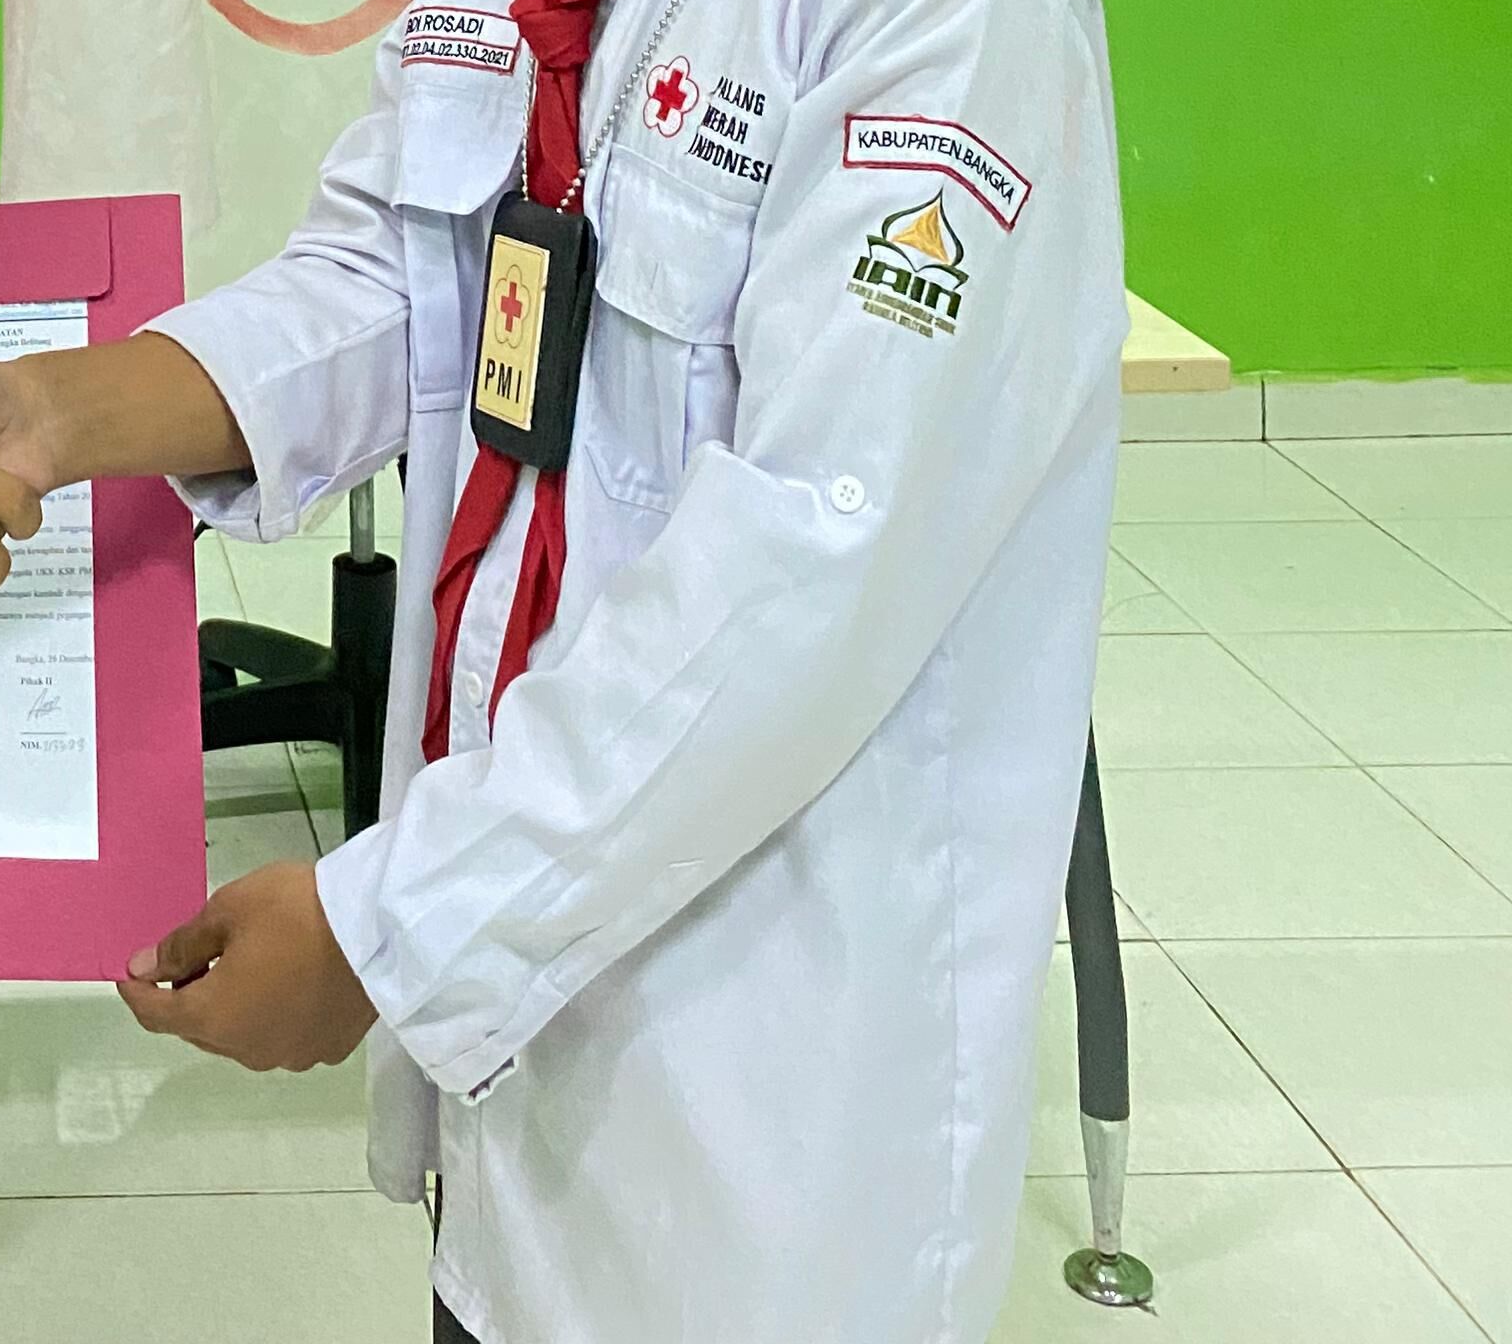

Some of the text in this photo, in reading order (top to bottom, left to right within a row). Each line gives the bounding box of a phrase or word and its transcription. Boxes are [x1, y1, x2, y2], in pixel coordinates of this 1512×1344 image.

[423, 13, 485, 36] ROSADI
[858, 130, 1016, 205] KABUPATEN BANGKA
[484, 358, 522, 405] PMI
